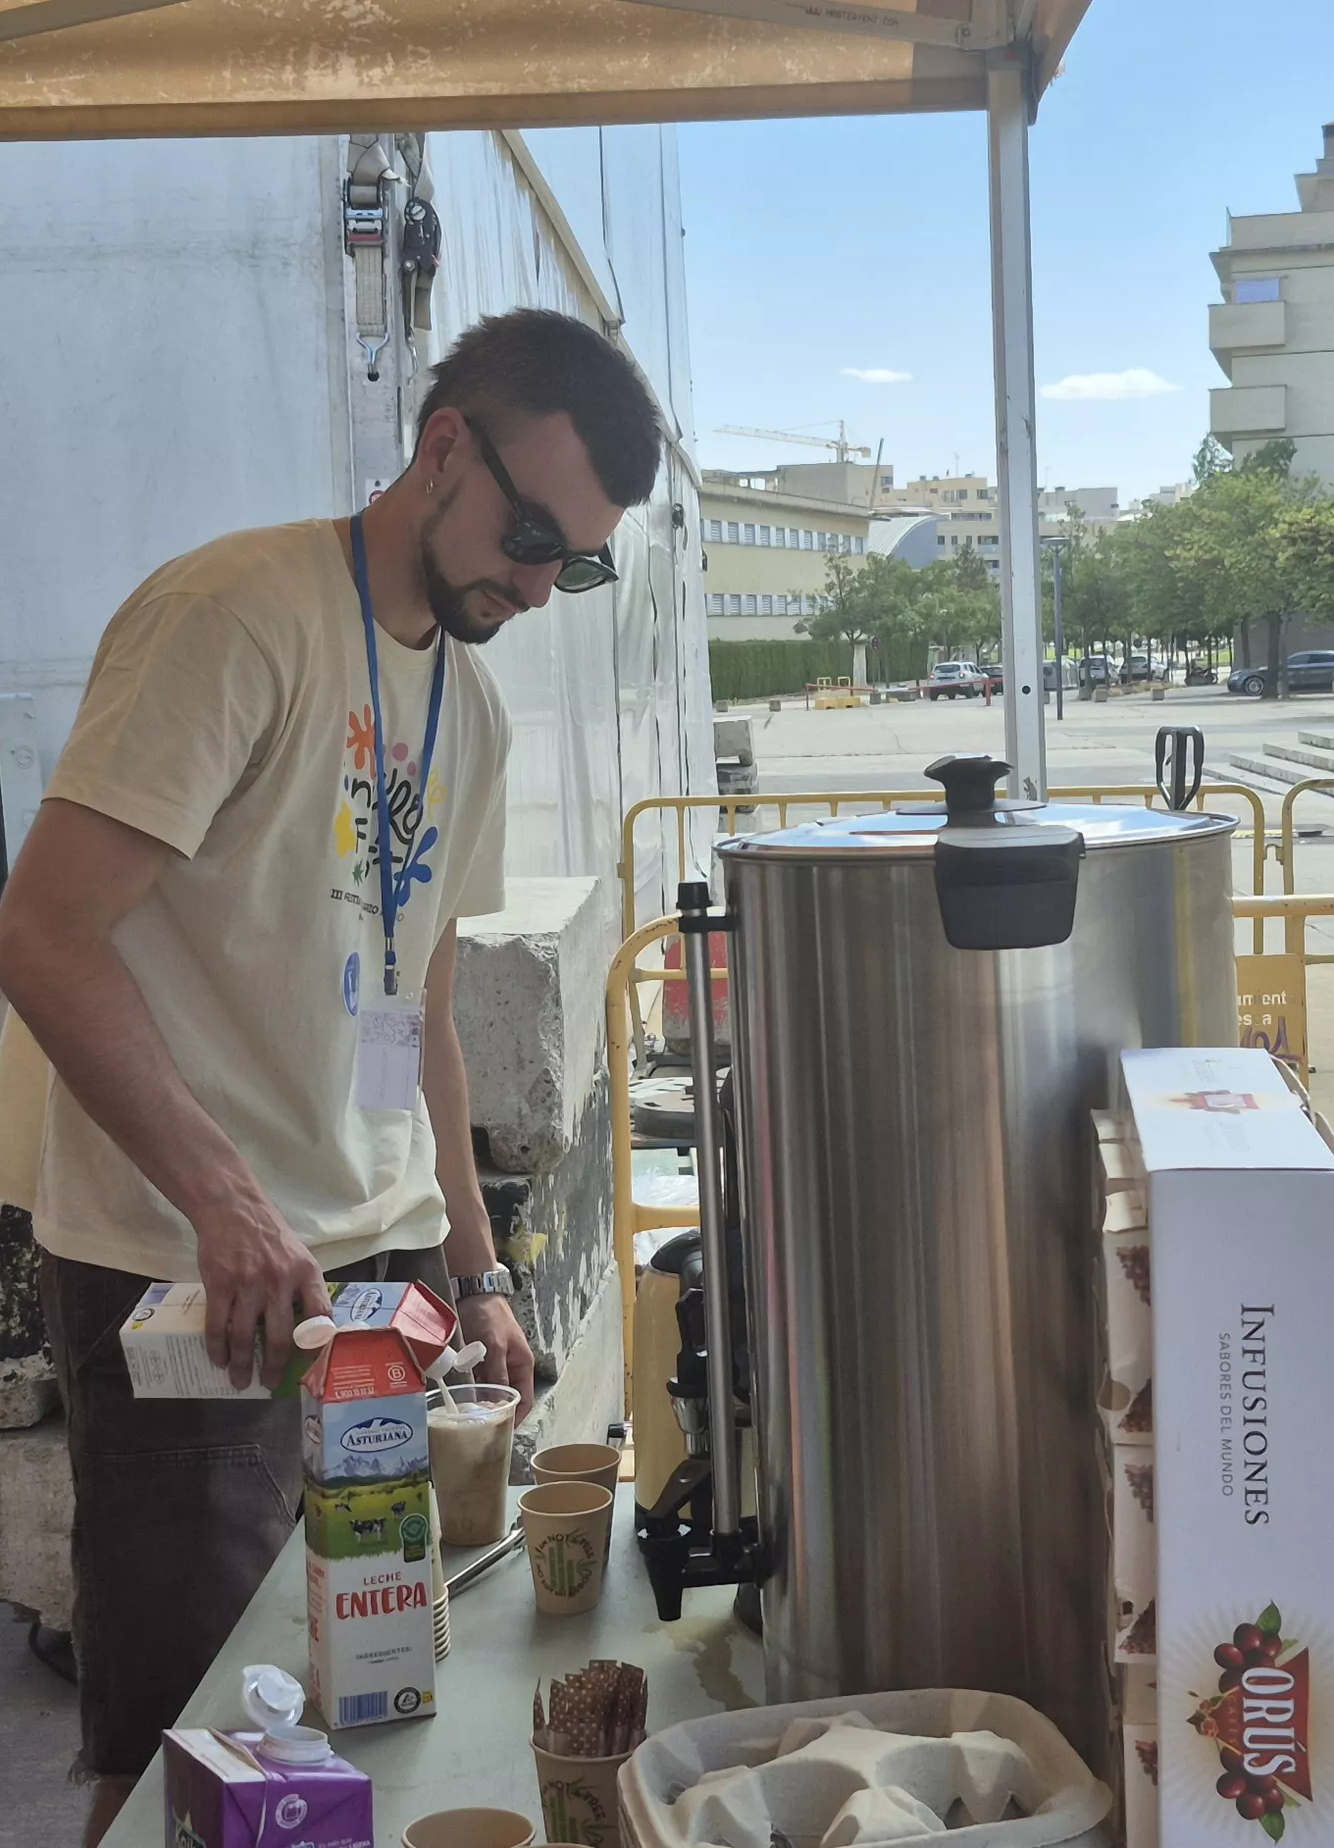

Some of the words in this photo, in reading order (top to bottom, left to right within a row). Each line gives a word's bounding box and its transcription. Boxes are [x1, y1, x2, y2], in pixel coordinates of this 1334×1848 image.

[1219, 1332, 1232, 1400] SABORES
[1220, 1405, 1232, 1433] DEL
[1240, 1303, 1275, 1525] INFUSIONES
[346, 1430, 408, 1447] ASTURIANA
[1221, 1439, 1234, 1497] MUNDO
[335, 1581, 428, 1620] ENTERA
[363, 1571, 402, 1586] LECHE
[1241, 1666, 1307, 1776] ORÚS
